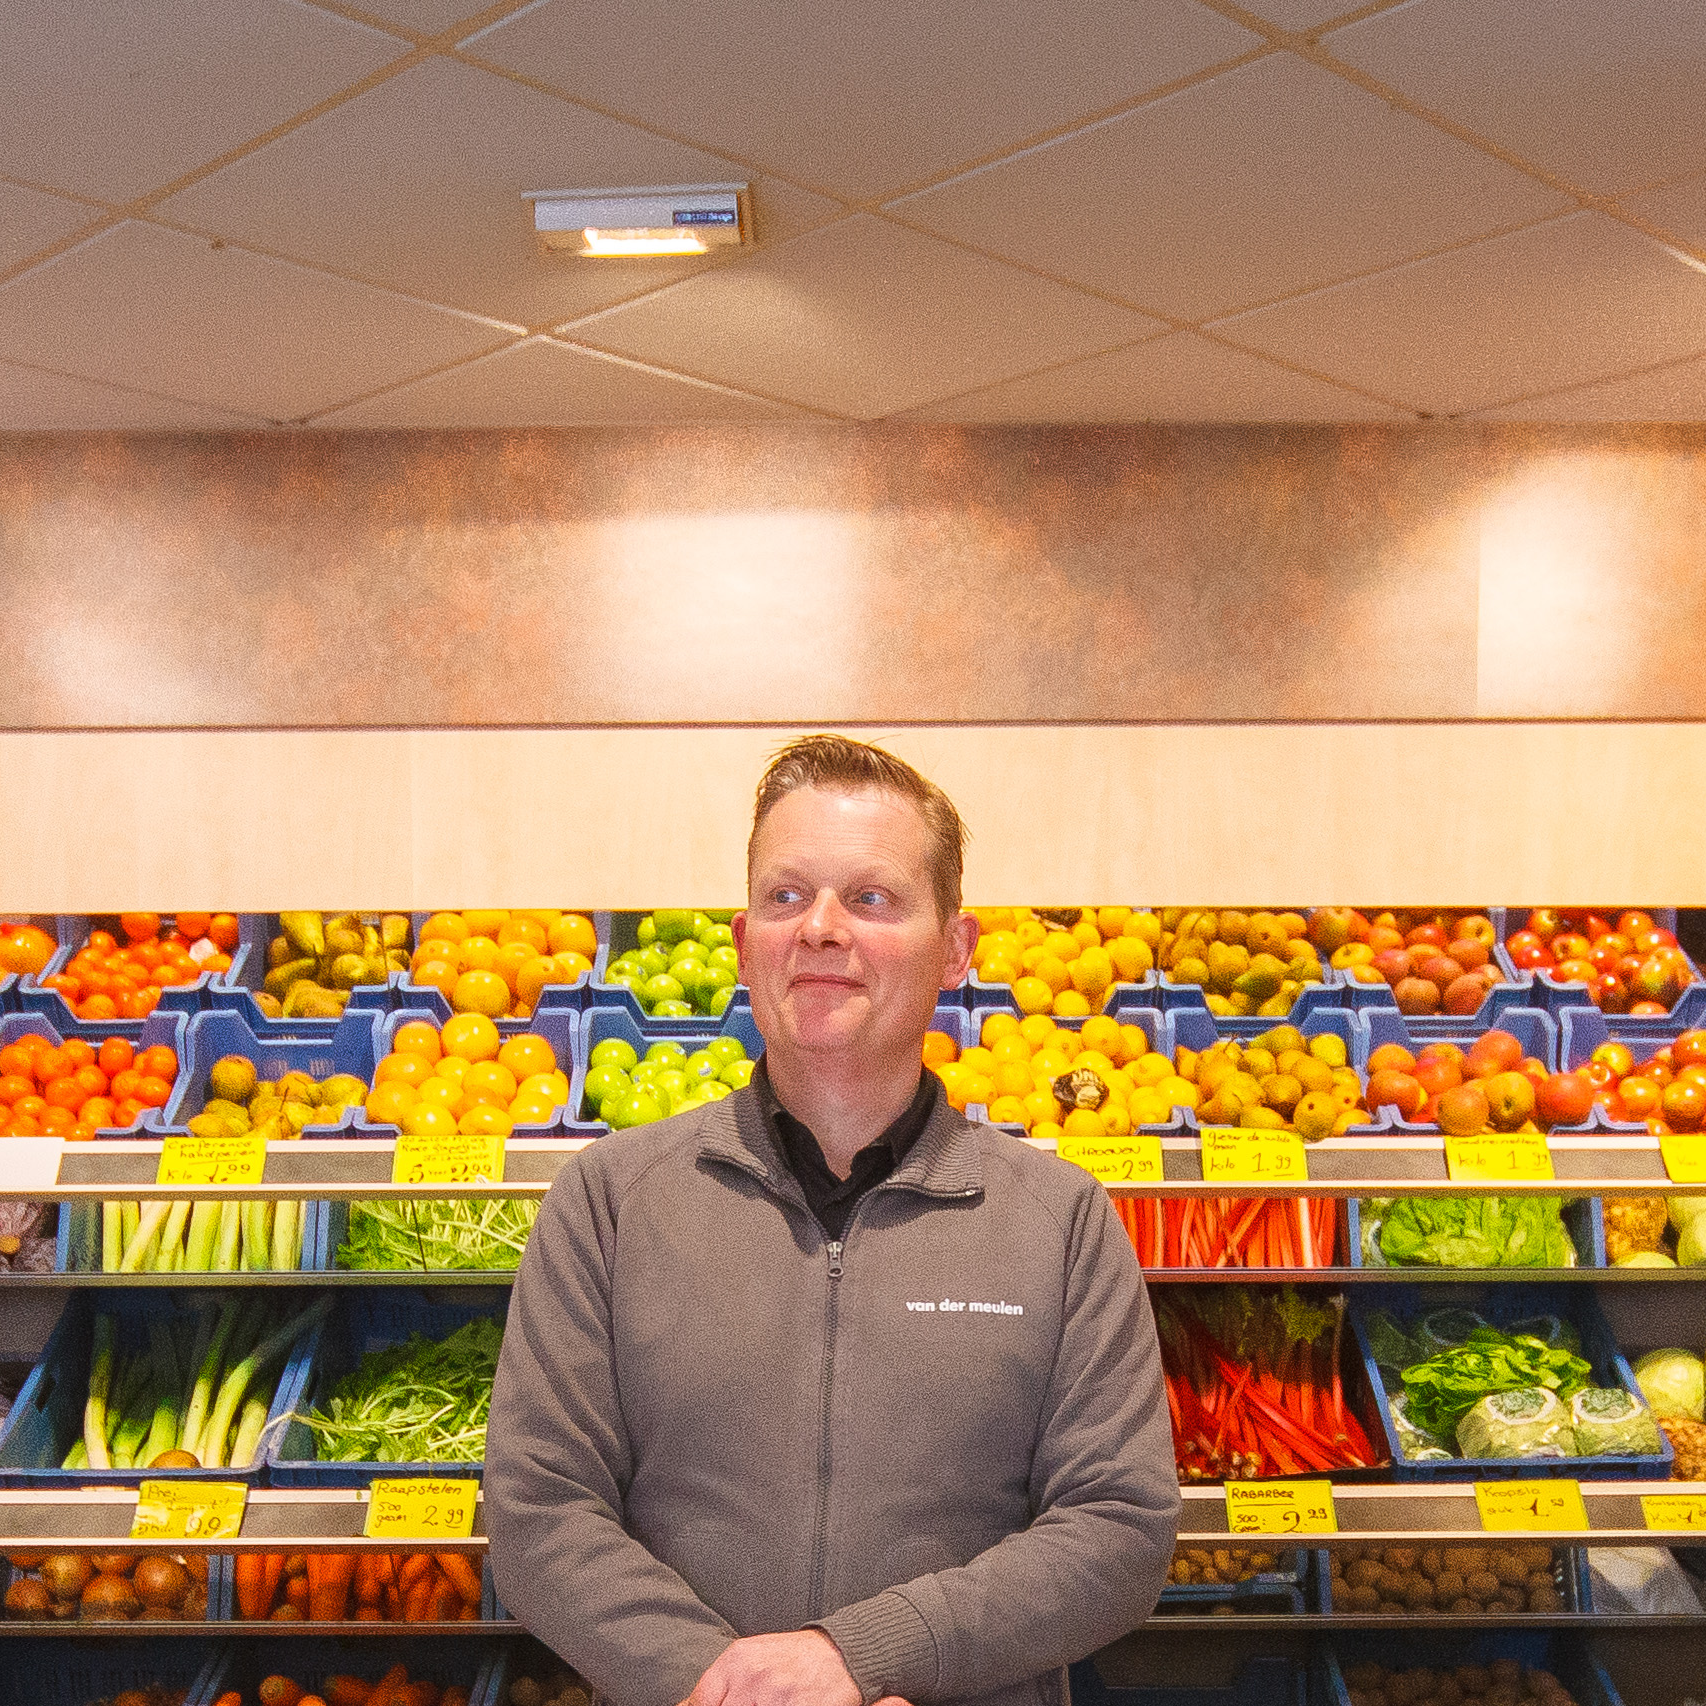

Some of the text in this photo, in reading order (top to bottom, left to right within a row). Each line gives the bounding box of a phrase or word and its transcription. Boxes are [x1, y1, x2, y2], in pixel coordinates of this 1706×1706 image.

[905, 1298, 1024, 1315] van der meulen
[377, 1481, 462, 1497] Raapstelen
